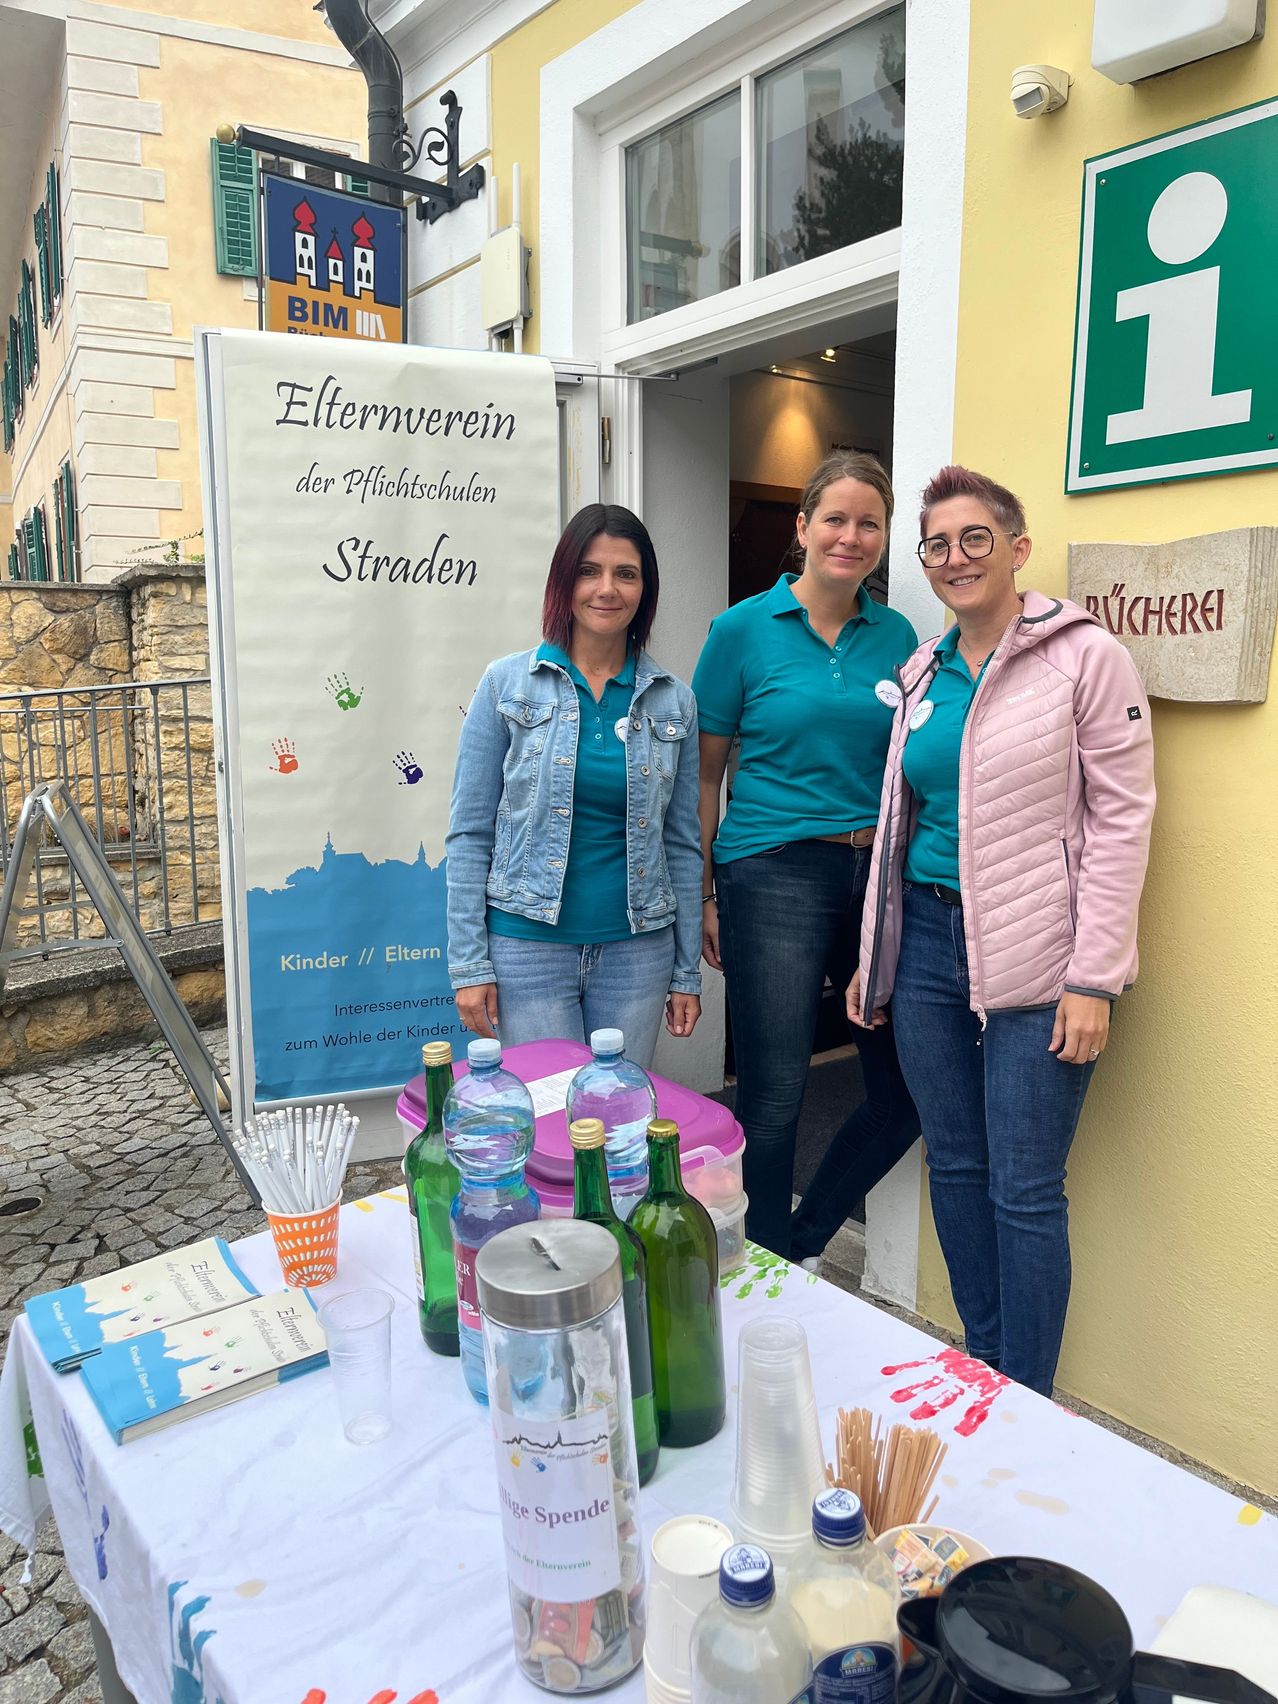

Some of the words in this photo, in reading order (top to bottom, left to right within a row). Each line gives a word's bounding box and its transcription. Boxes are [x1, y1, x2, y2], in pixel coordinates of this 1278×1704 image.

[288, 295, 348, 332] BIM
[275, 375, 516, 441] Elternverein
[296, 461, 335, 494] der
[343, 465, 497, 504] Pflichtschulen
[322, 532, 478, 586] Straden
[281, 951, 349, 972] Kinder
[385, 944, 441, 963] Eltern
[334, 994, 456, 1017] Interessenvertre
[285, 1038, 318, 1051] zum
[322, 1031, 372, 1049] Wohle
[376, 1028, 403, 1042] der
[406, 1022, 455, 1039] Kinder
[534, 1498, 610, 1529] Spende
